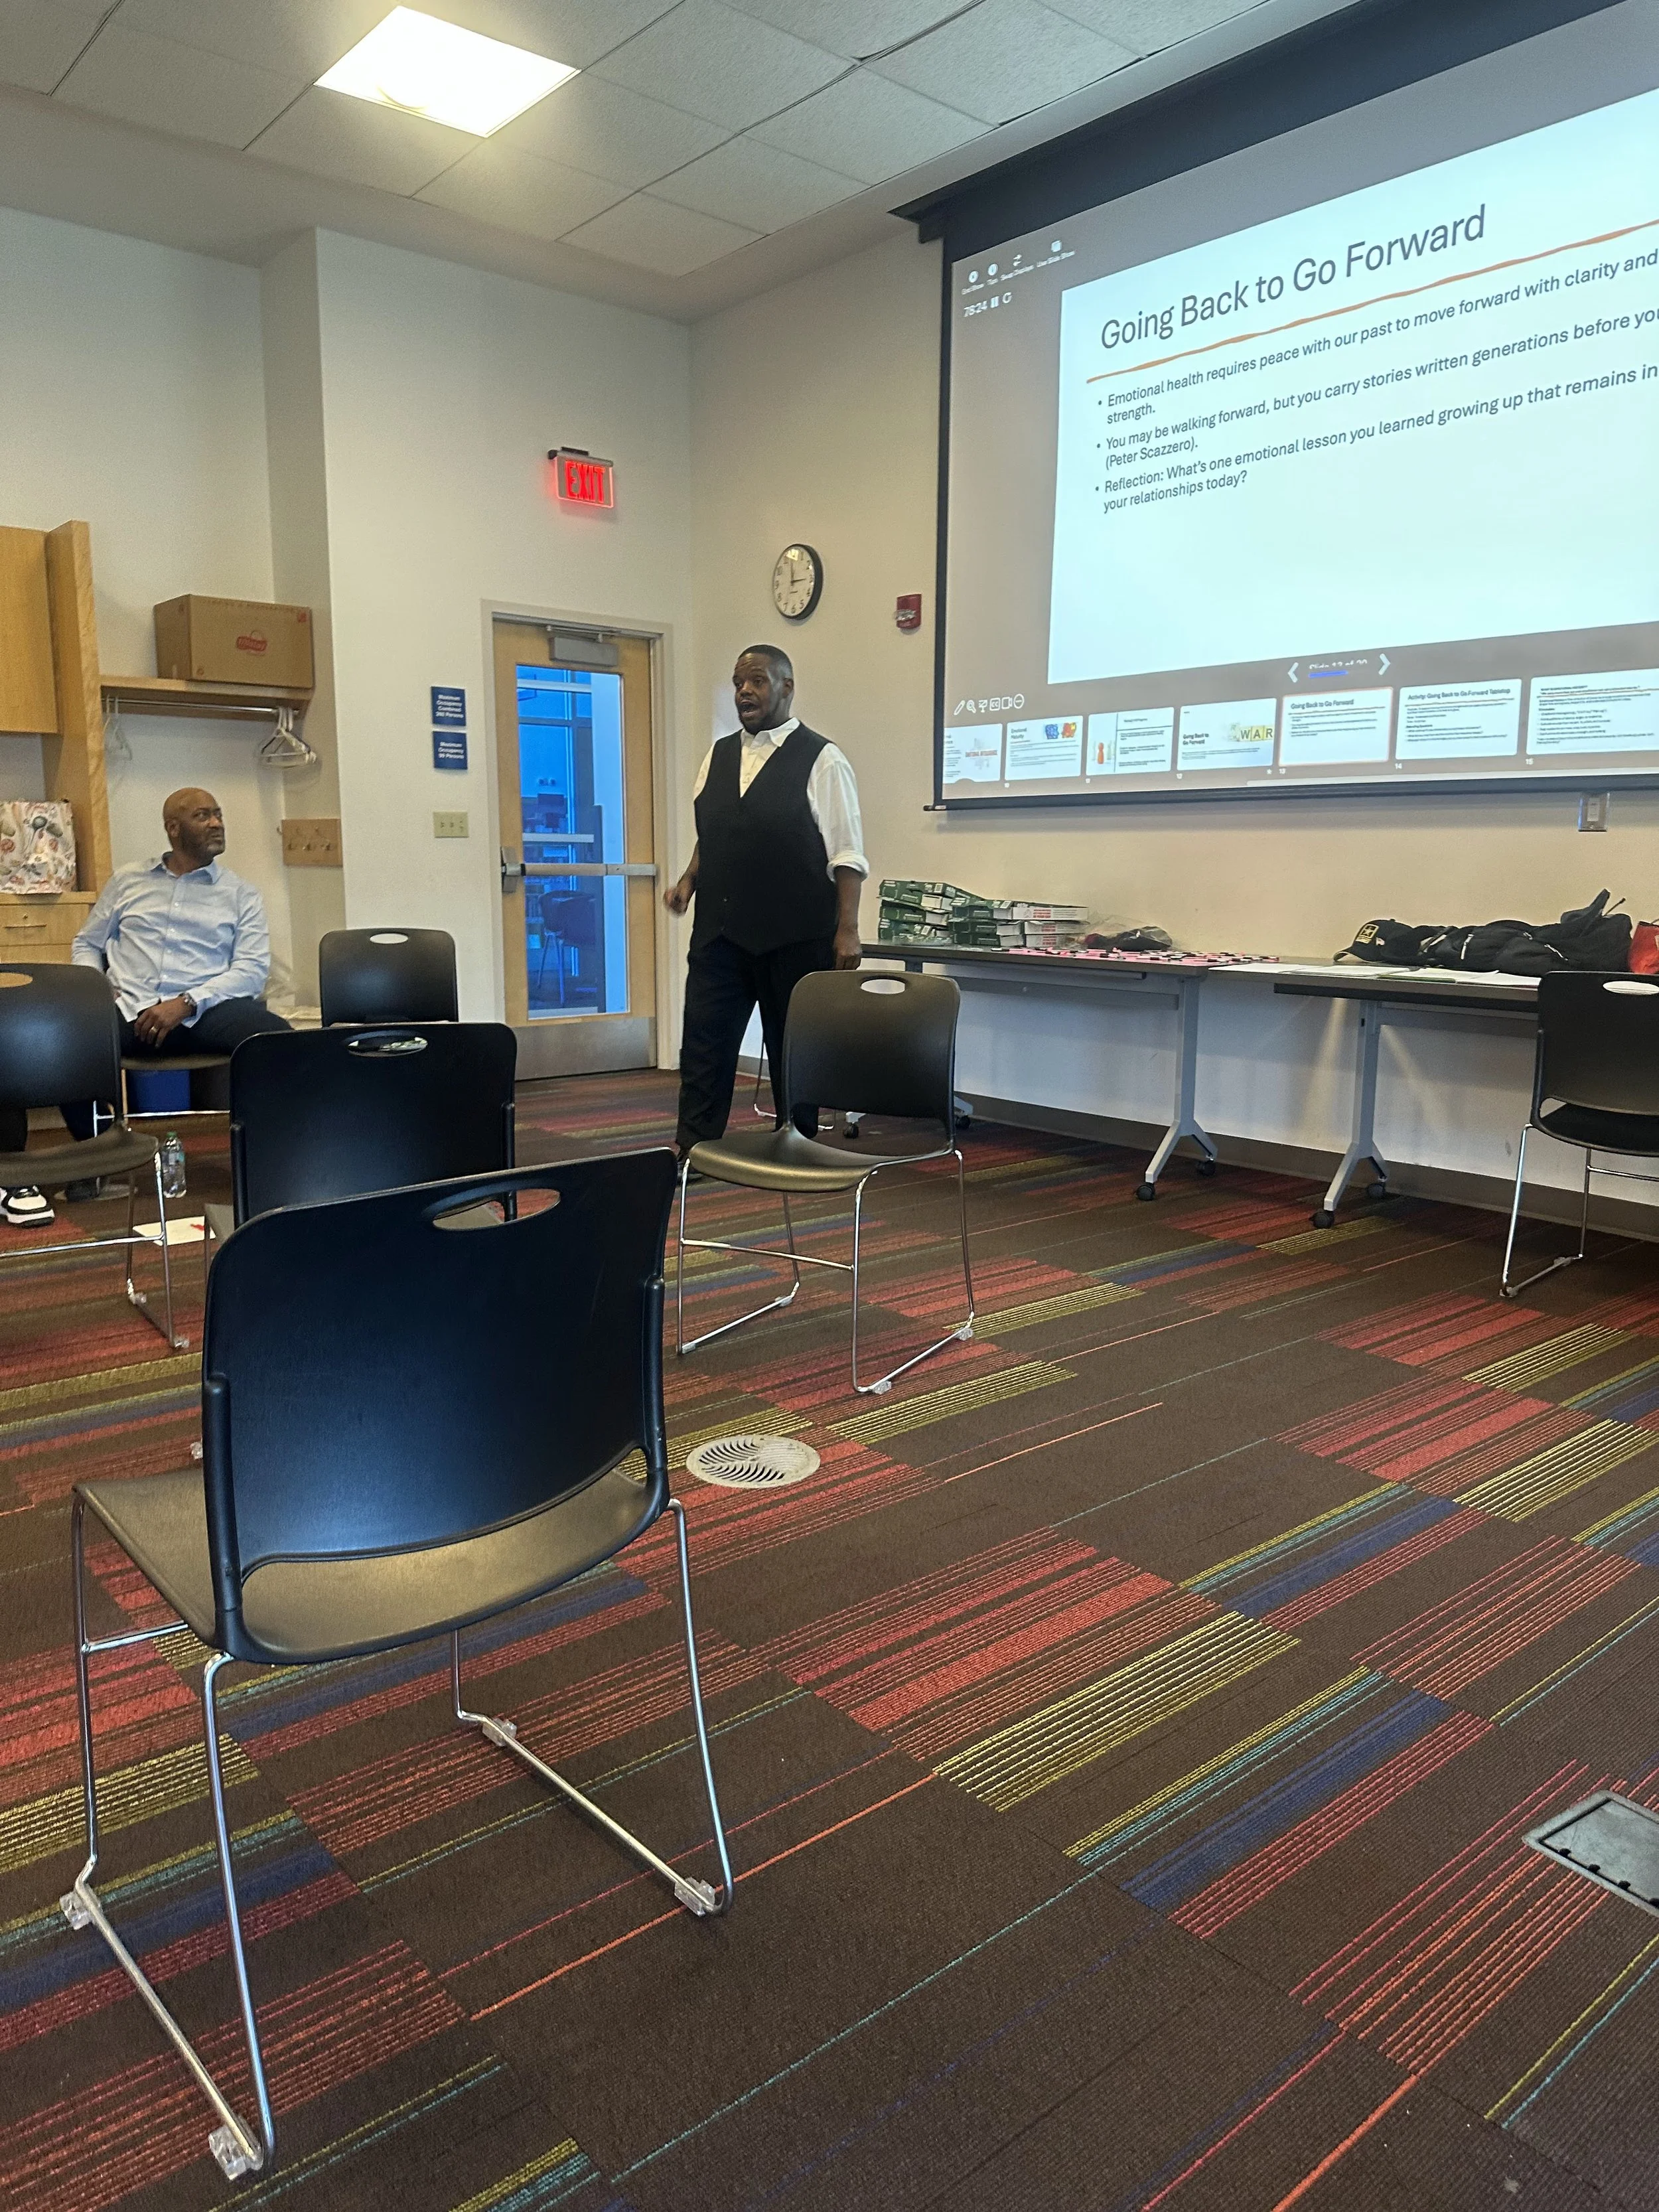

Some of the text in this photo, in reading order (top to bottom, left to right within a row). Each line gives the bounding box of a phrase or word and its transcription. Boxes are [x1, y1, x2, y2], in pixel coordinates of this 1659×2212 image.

[1102, 204, 1485, 348] Going Back to Go Forward
[1108, 248, 1658, 406] Emotional health requires peace with our past to move forward with clarity and
[1106, 435, 1125, 449] You
[1129, 430, 1153, 445] may
[1155, 426, 1169, 439] be
[1171, 414, 1216, 435] walking
[1218, 400, 1269, 423] forward,
[1273, 395, 1295, 410] but
[1297, 390, 1321, 407] you
[1325, 380, 1360, 399] carry
[1363, 368, 1412, 389] stories
[1415, 354, 1469, 378] written
[1472, 330, 1569, 366] generations
[1573, 315, 1630, 340] before
[1105, 471, 1164, 492] Reflection:
[1209, 457, 1232, 470] one
[1235, 440, 1299, 465] emotional
[1303, 432, 1346, 451] lesson
[1350, 426, 1375, 444] you
[1379, 409, 1434, 435] learned
[1438, 398, 1499, 425] growing
[1502, 394, 1523, 410] up
[1528, 384, 1561, 403] that
[1565, 370, 1636, 396] remains
[1642, 364, 1658, 380] in
[1107, 403, 1155, 424] strength.
[1106, 437, 1198, 470] (Peter Scazzero).
[565, 461, 605, 504] EXIT
[1104, 470, 1248, 514] your relationships today?
[1240, 728, 1273, 739] WAR
